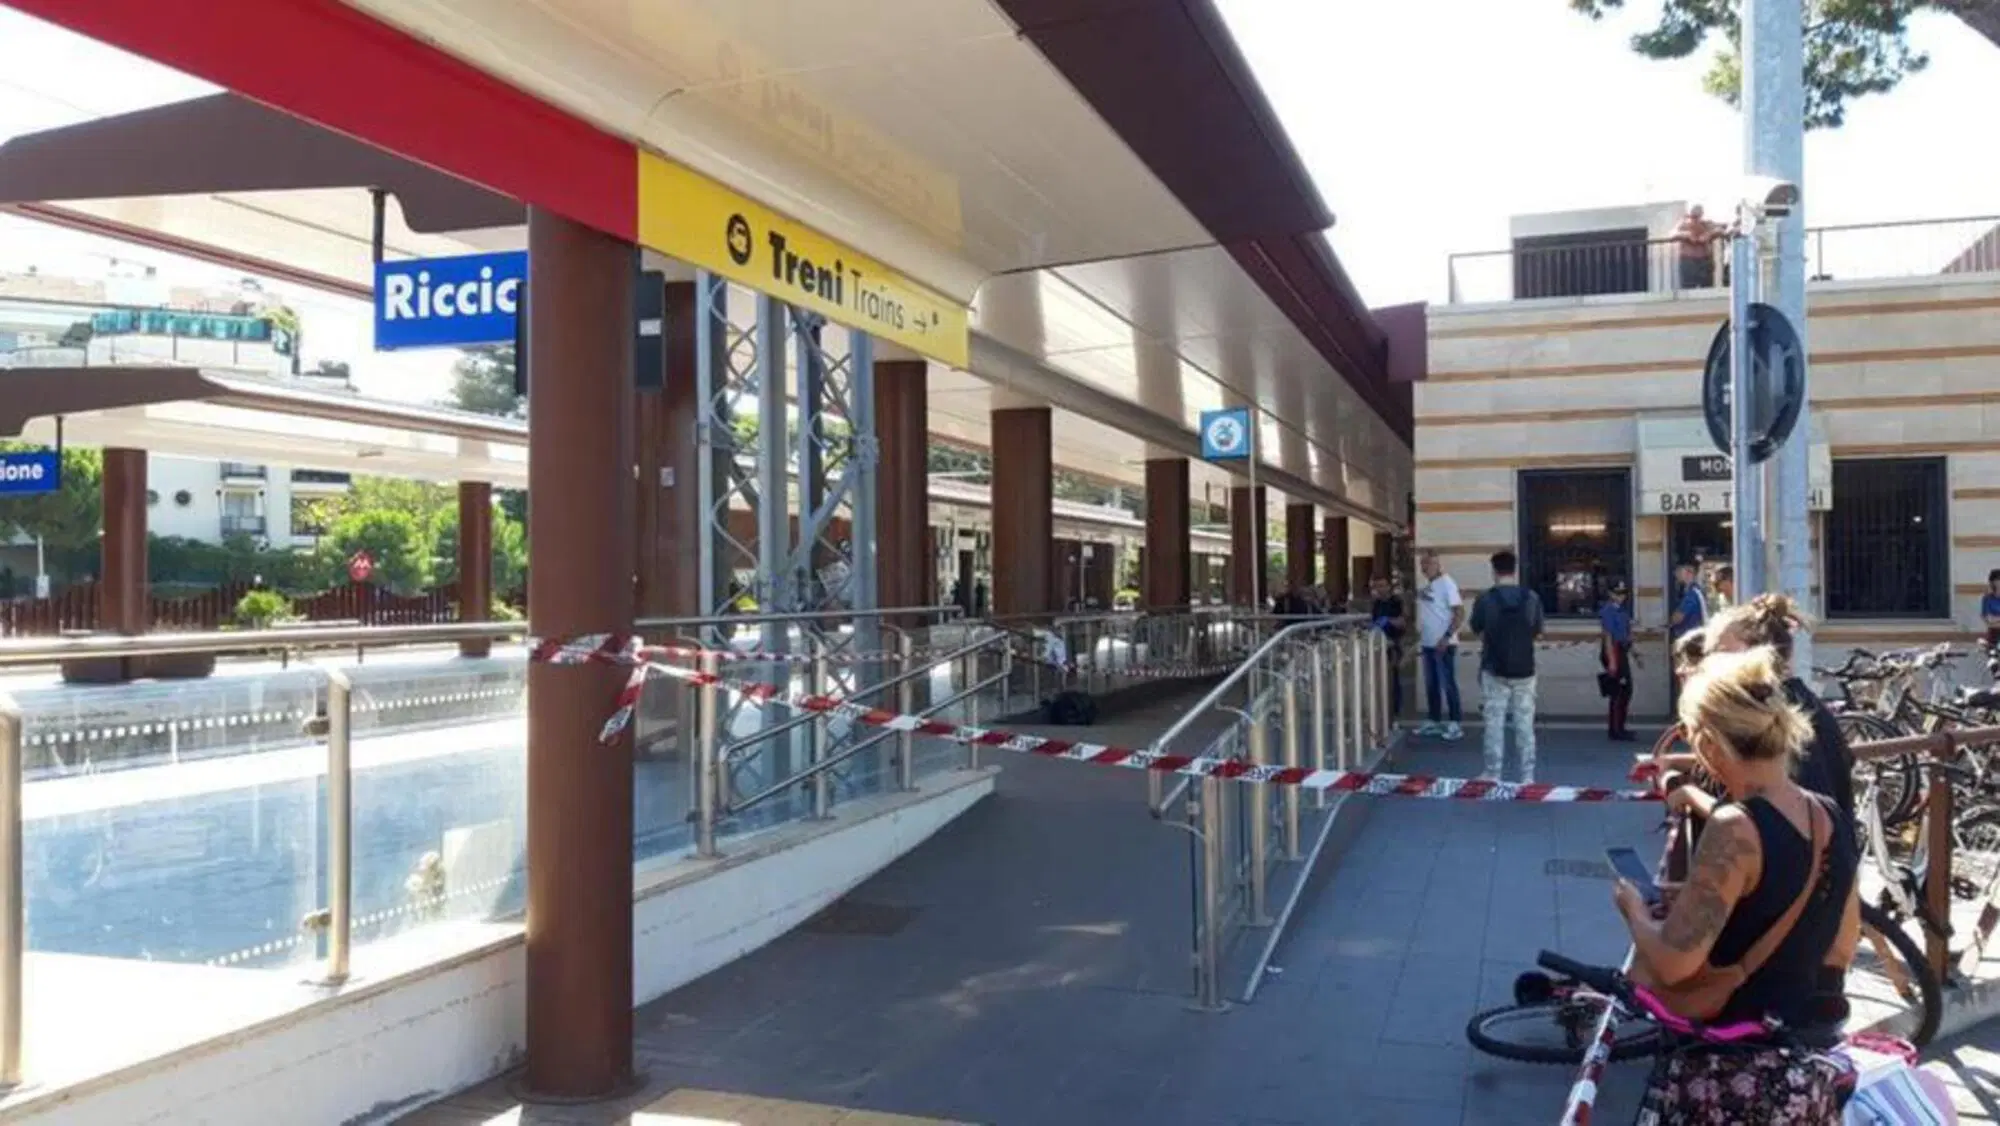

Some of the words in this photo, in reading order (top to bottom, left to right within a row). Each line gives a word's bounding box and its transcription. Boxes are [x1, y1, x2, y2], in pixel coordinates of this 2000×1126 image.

[767, 229, 844, 307] Treni
[850, 268, 905, 330] Trains
[1660, 493, 1701, 512] BAR
